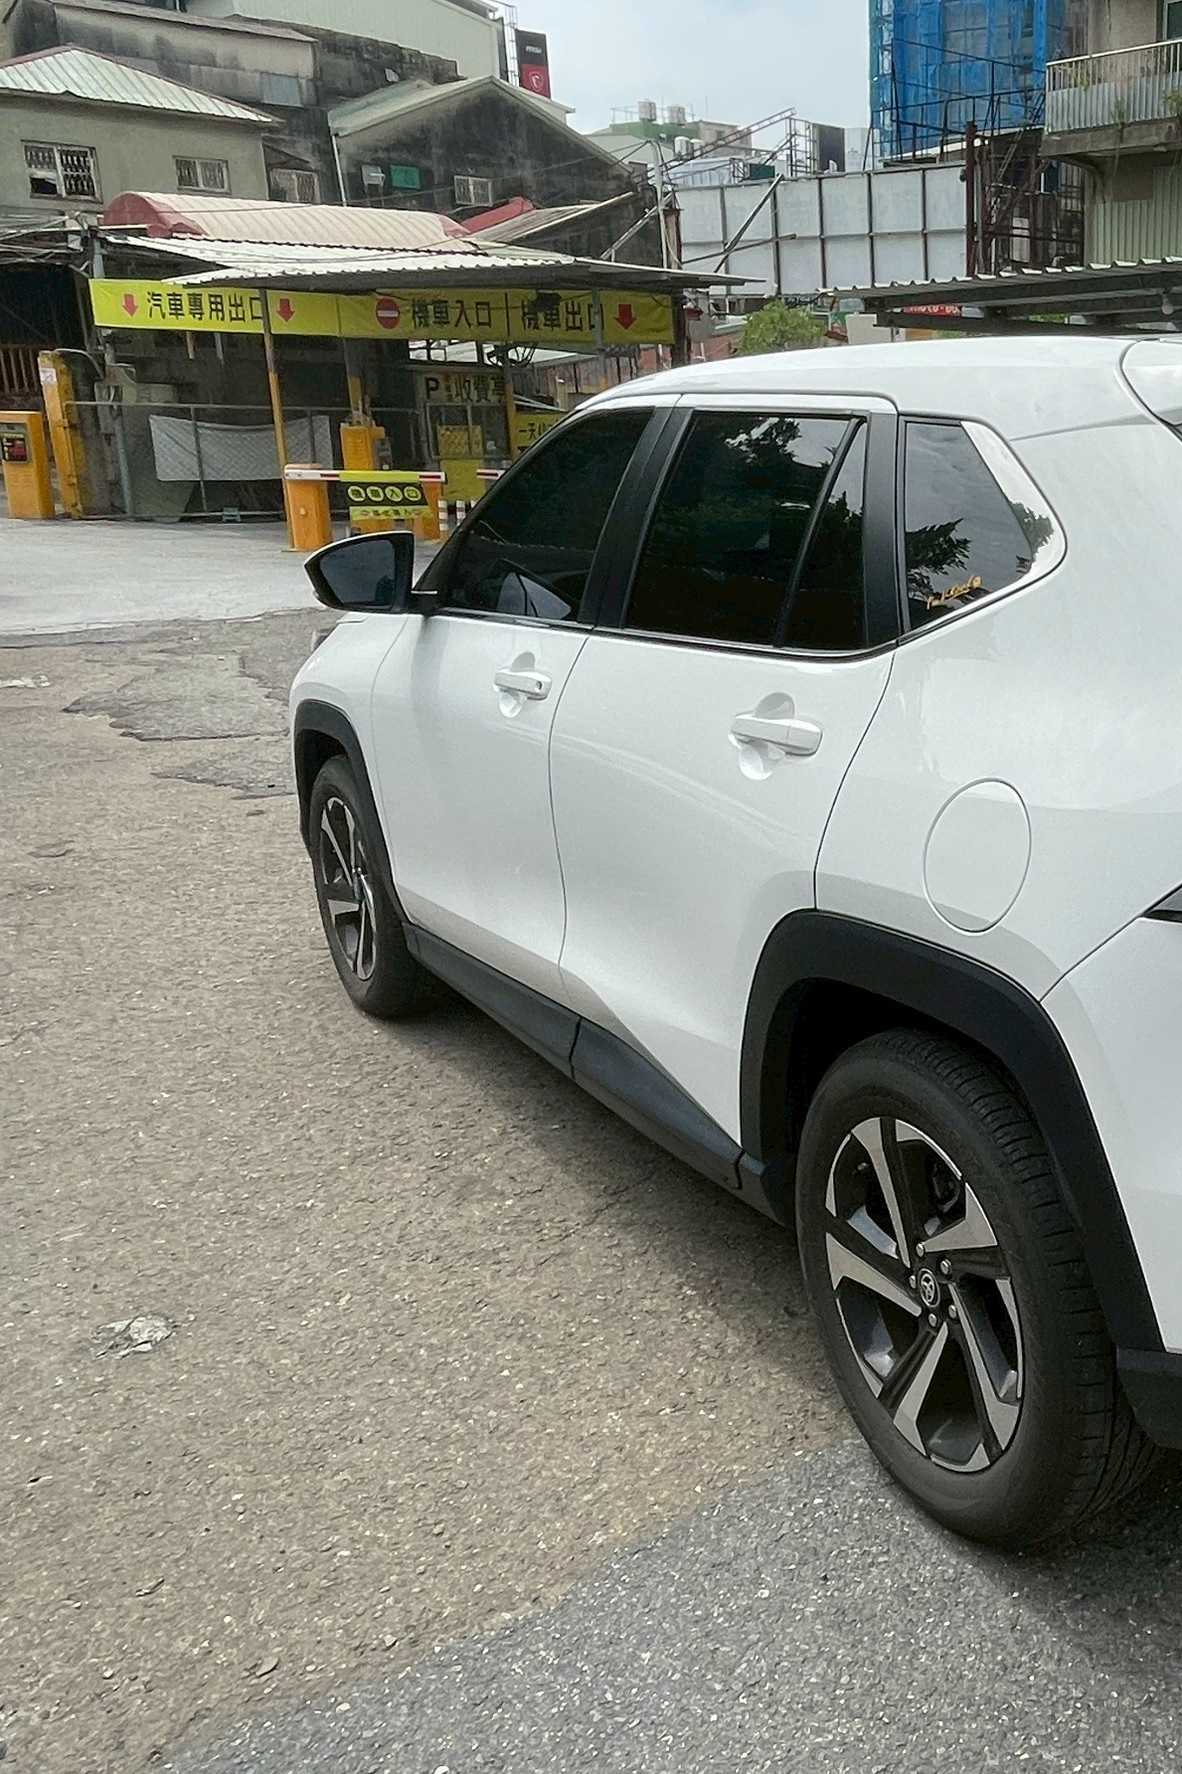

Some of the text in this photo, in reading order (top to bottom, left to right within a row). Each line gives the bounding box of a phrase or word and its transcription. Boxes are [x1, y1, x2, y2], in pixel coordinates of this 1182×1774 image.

[411, 300, 492, 329] 機車入口
[425, 376, 440, 399] P
